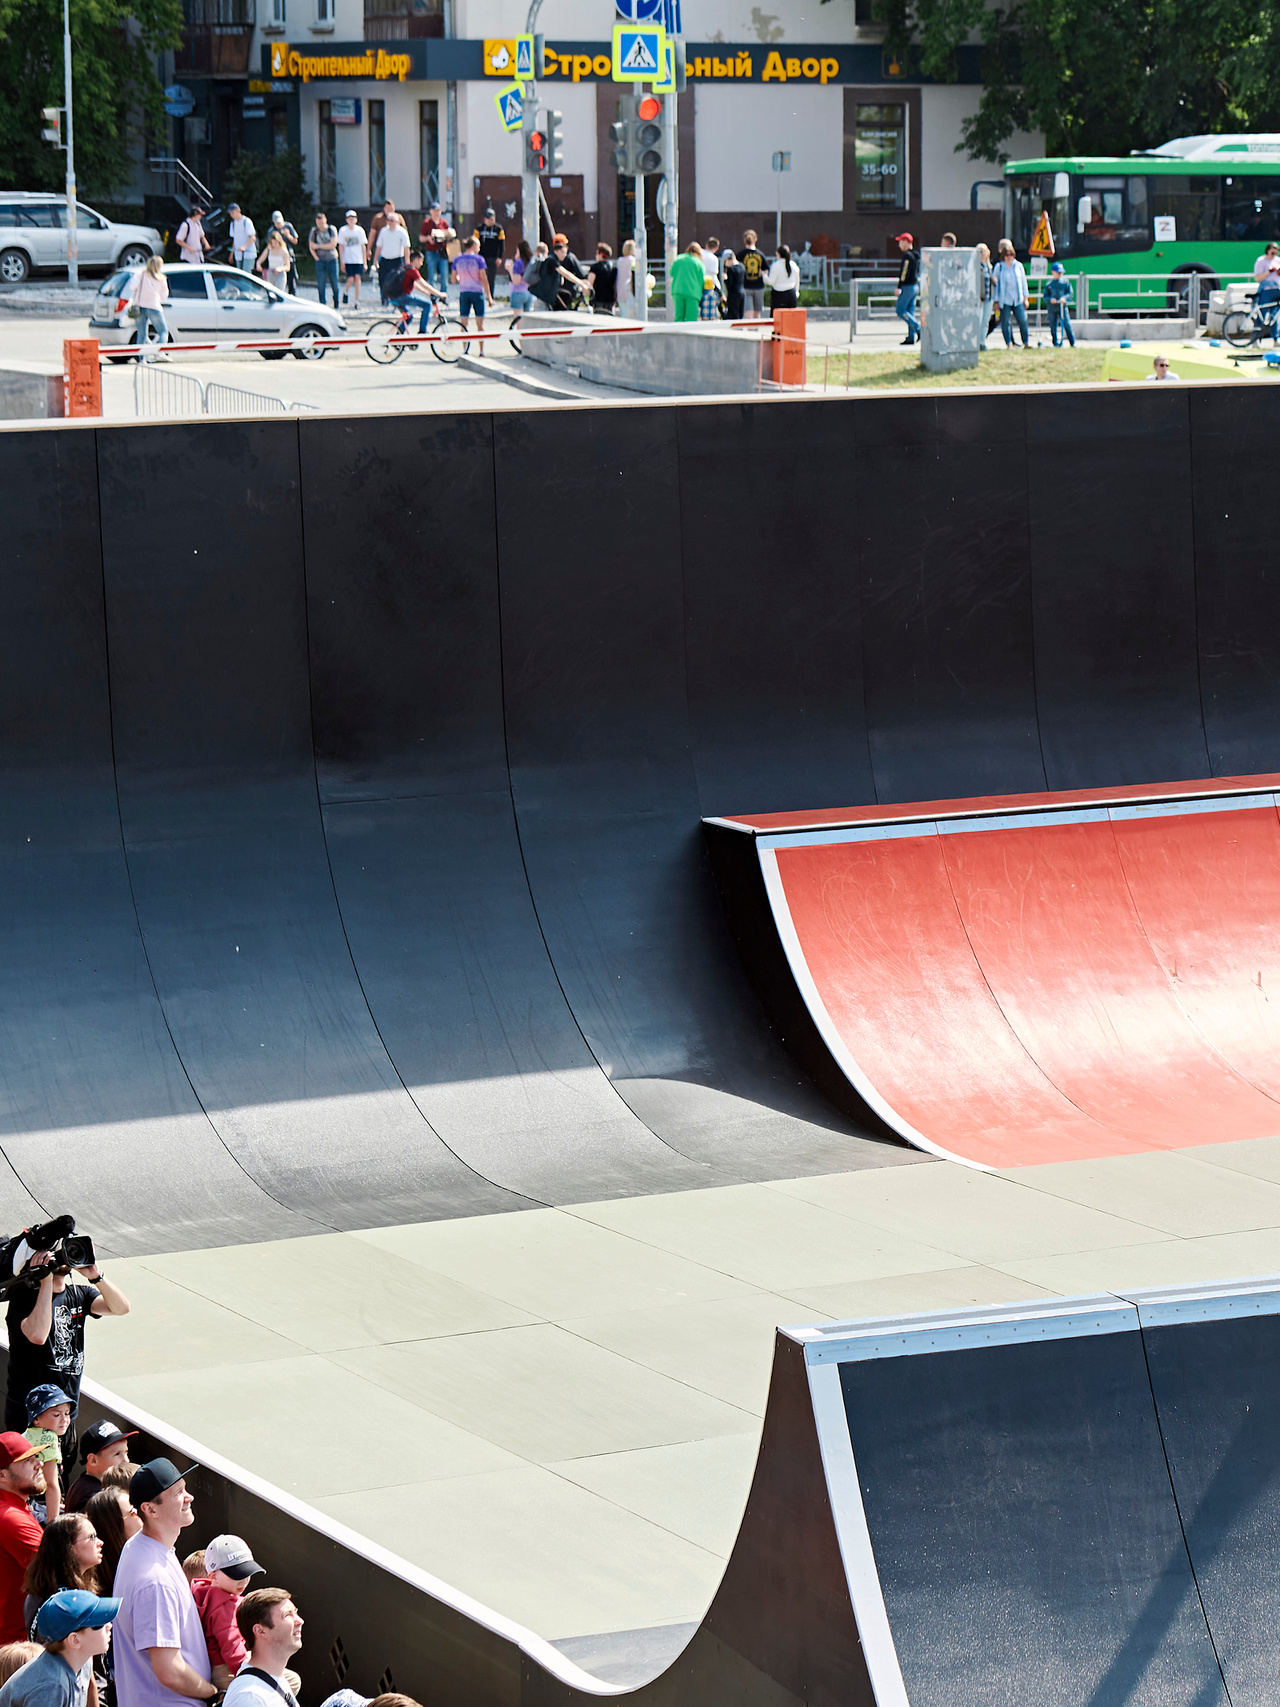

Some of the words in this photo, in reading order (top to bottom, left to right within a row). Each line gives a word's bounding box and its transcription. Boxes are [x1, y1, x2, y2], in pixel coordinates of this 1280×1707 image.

[289, 49, 375, 82] Строительный
[375, 48, 411, 82] Двор
[762, 51, 839, 84] Двор
